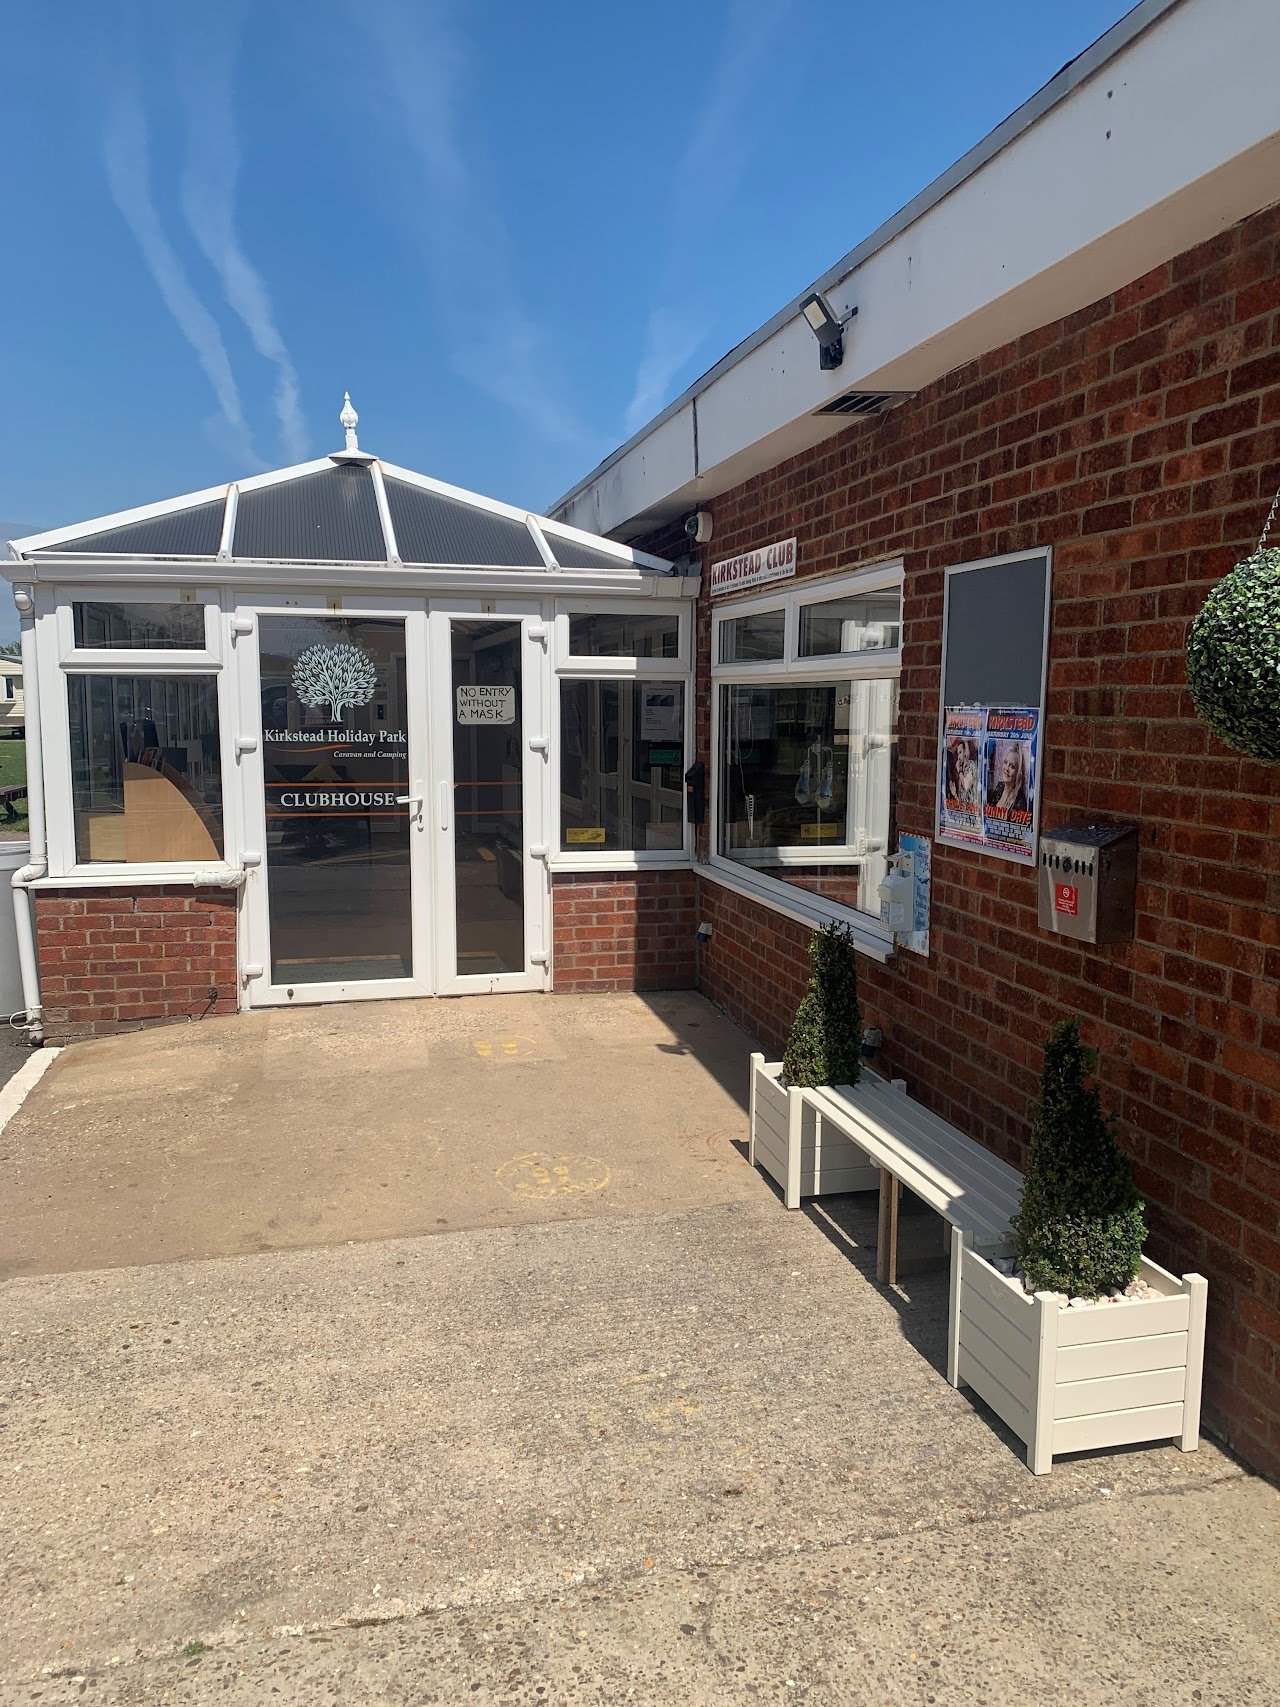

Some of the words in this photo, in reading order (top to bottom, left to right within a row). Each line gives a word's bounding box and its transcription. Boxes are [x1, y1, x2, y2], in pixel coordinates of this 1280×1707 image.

[712, 553, 761, 585] KIRKSTEAD
[766, 542, 793, 569] CLUB
[460, 687, 477, 698] NO
[479, 687, 512, 697] ENTRY
[459, 699, 507, 708] WITHOUT
[458, 709, 467, 719] A
[470, 709, 504, 719] MASK
[264, 729, 325, 742] Kirkstead
[327, 729, 377, 746] Holiday
[379, 730, 407, 743] Park
[377, 751, 407, 759] Camping
[280, 792, 395, 807] CLUBHOUSE
